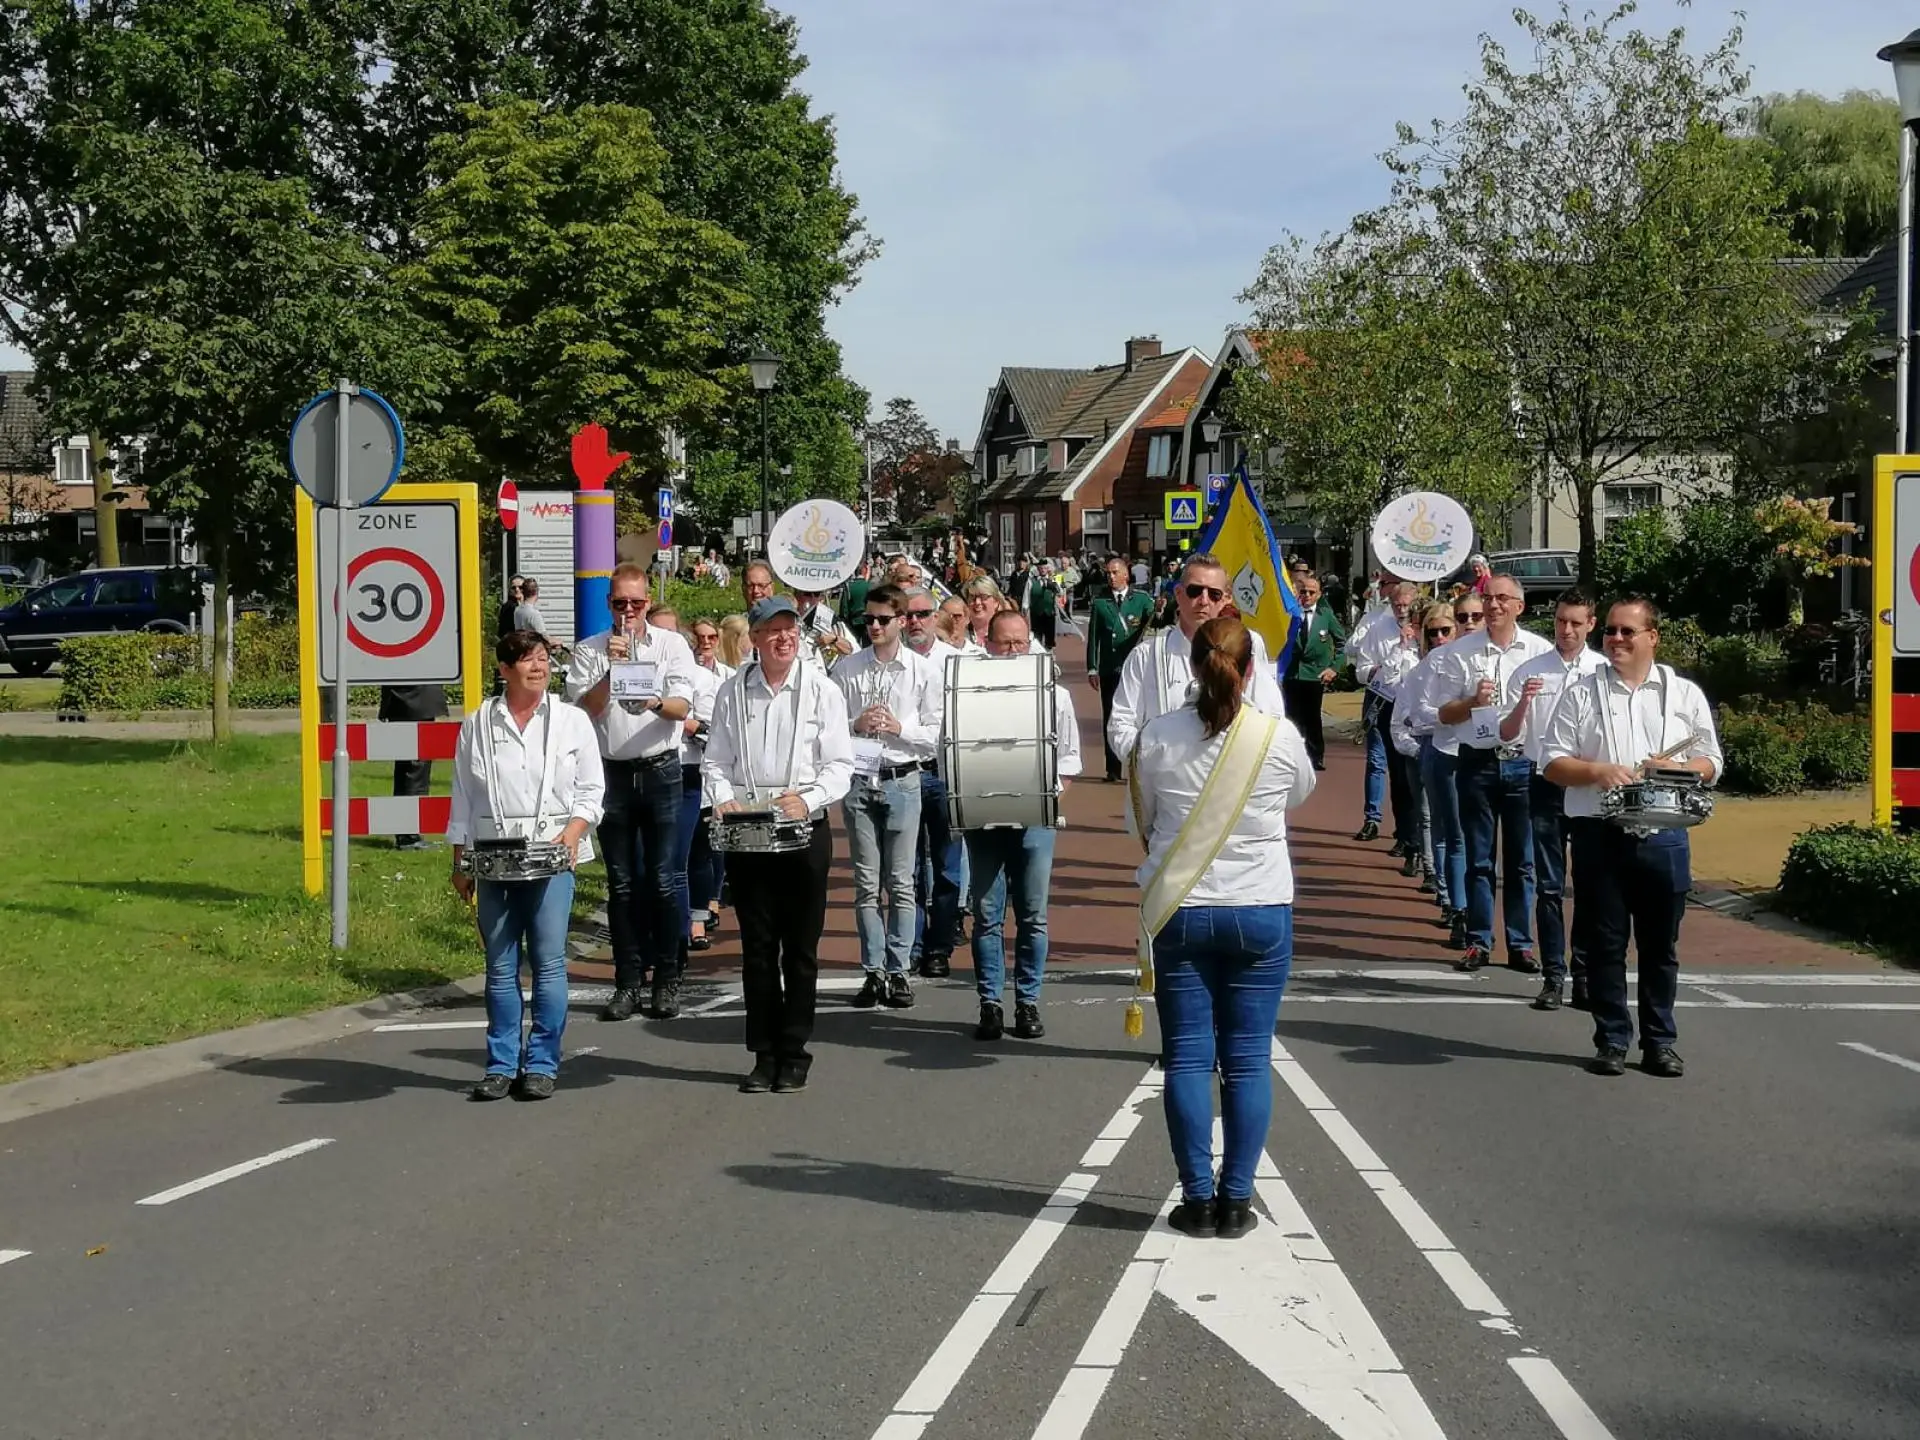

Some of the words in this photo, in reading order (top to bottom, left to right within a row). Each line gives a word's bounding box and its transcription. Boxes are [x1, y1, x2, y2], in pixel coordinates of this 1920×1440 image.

[358, 514, 418, 530] ZONE
[1388, 556, 1446, 572] AMICITIA
[784, 566, 841, 579] AMICITIA
[357, 583, 423, 622] 30
